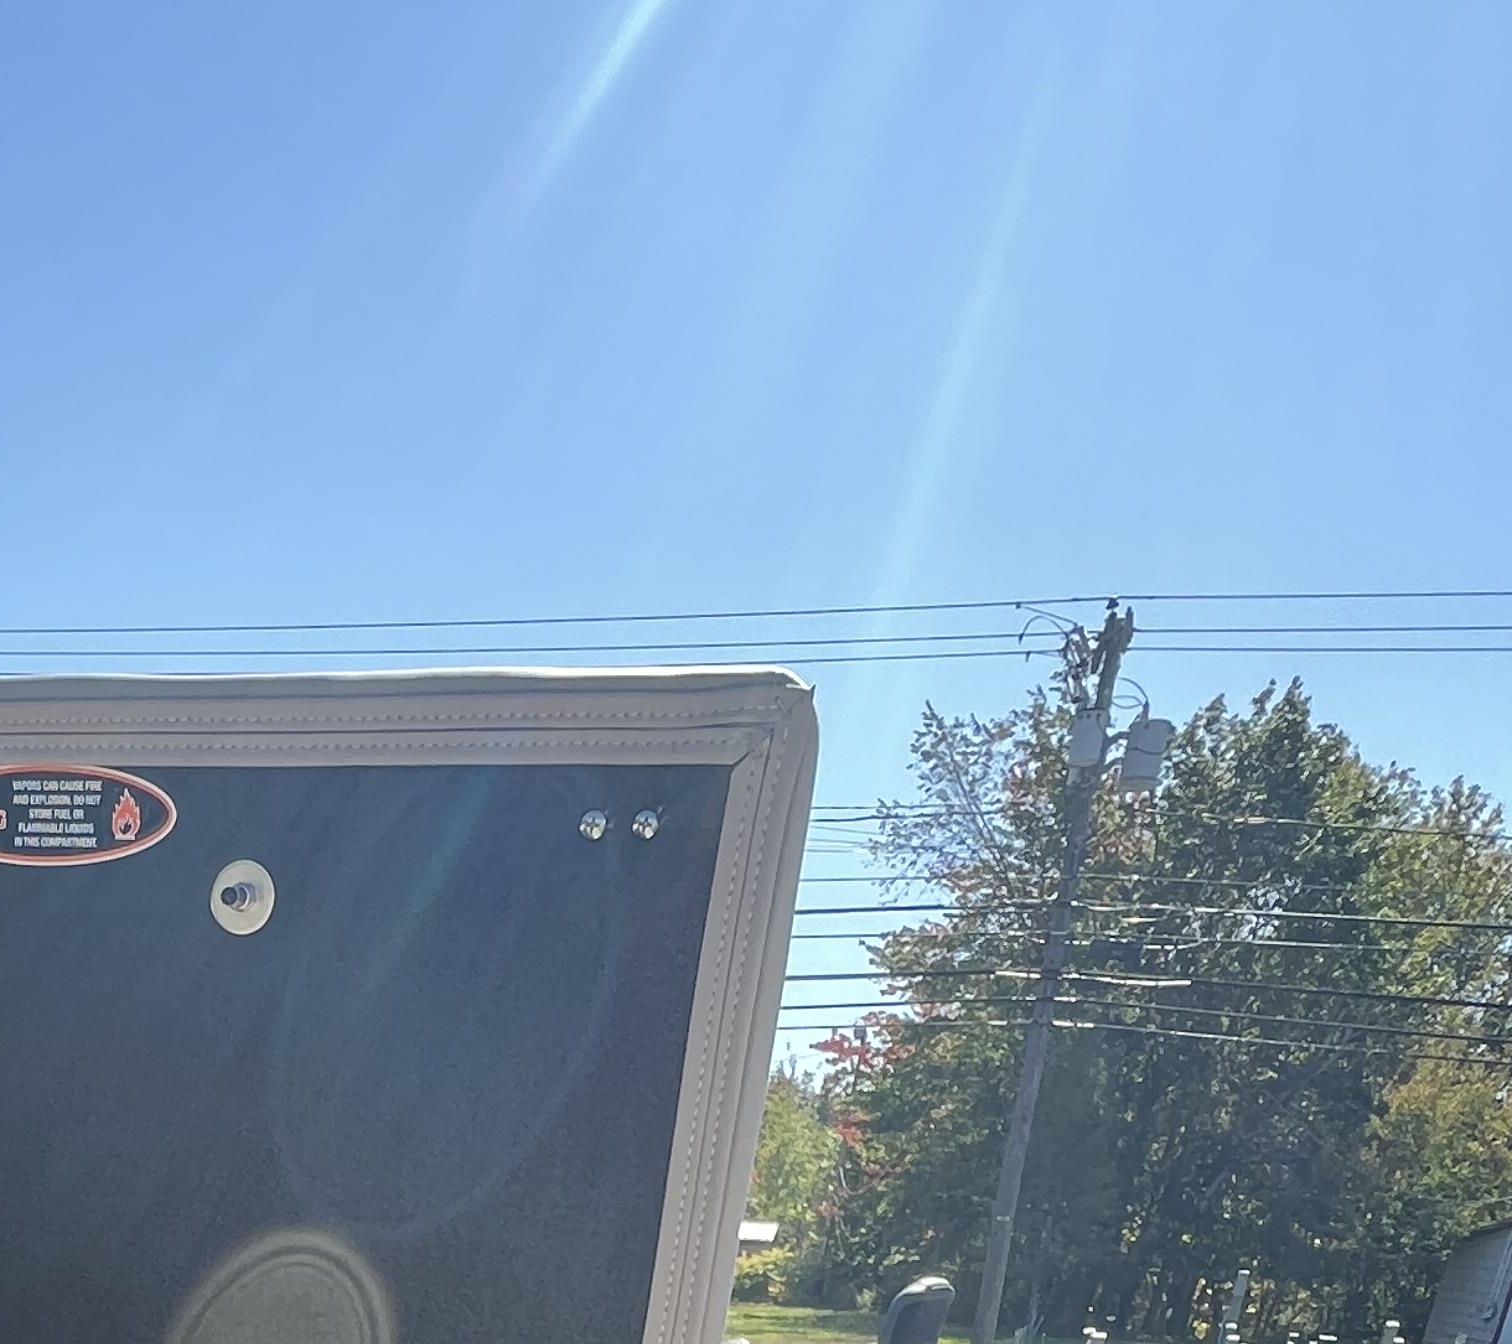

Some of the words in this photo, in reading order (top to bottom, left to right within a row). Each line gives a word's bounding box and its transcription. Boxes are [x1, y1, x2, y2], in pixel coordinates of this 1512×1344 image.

[60, 780, 84, 791] CAUSE
[54, 809, 71, 820] FUEL
[73, 809, 84, 819] OR
[23, 837, 39, 847] THIS
